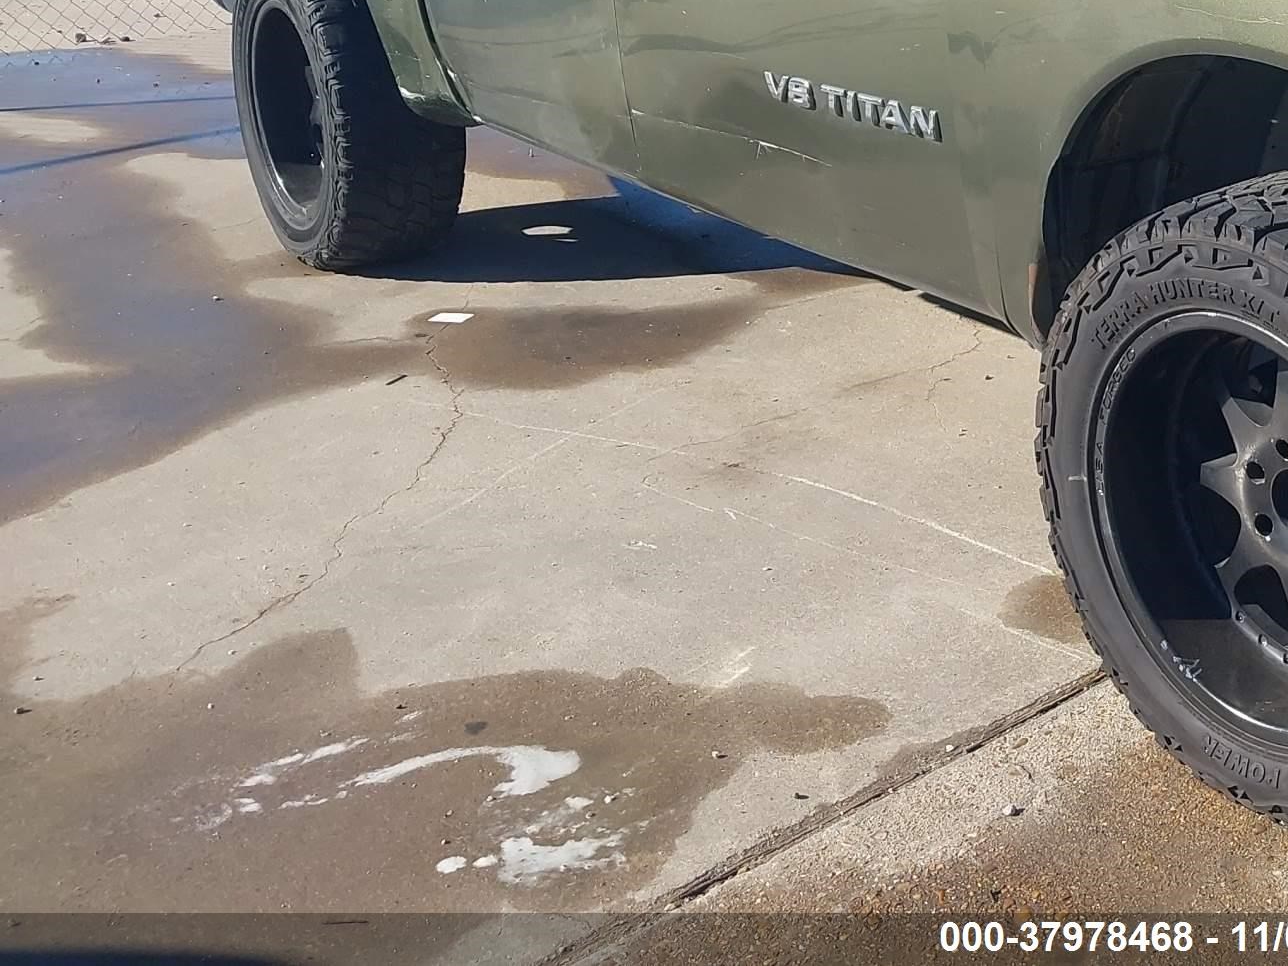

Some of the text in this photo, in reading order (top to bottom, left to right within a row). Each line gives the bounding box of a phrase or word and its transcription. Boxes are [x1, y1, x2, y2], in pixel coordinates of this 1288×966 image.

[763, 70, 943, 143] V8 TITAN
[1091, 290, 1149, 349] TERRA
[1150, 278, 1236, 306] HUNTER
[1203, 735, 1281, 790] POWER
